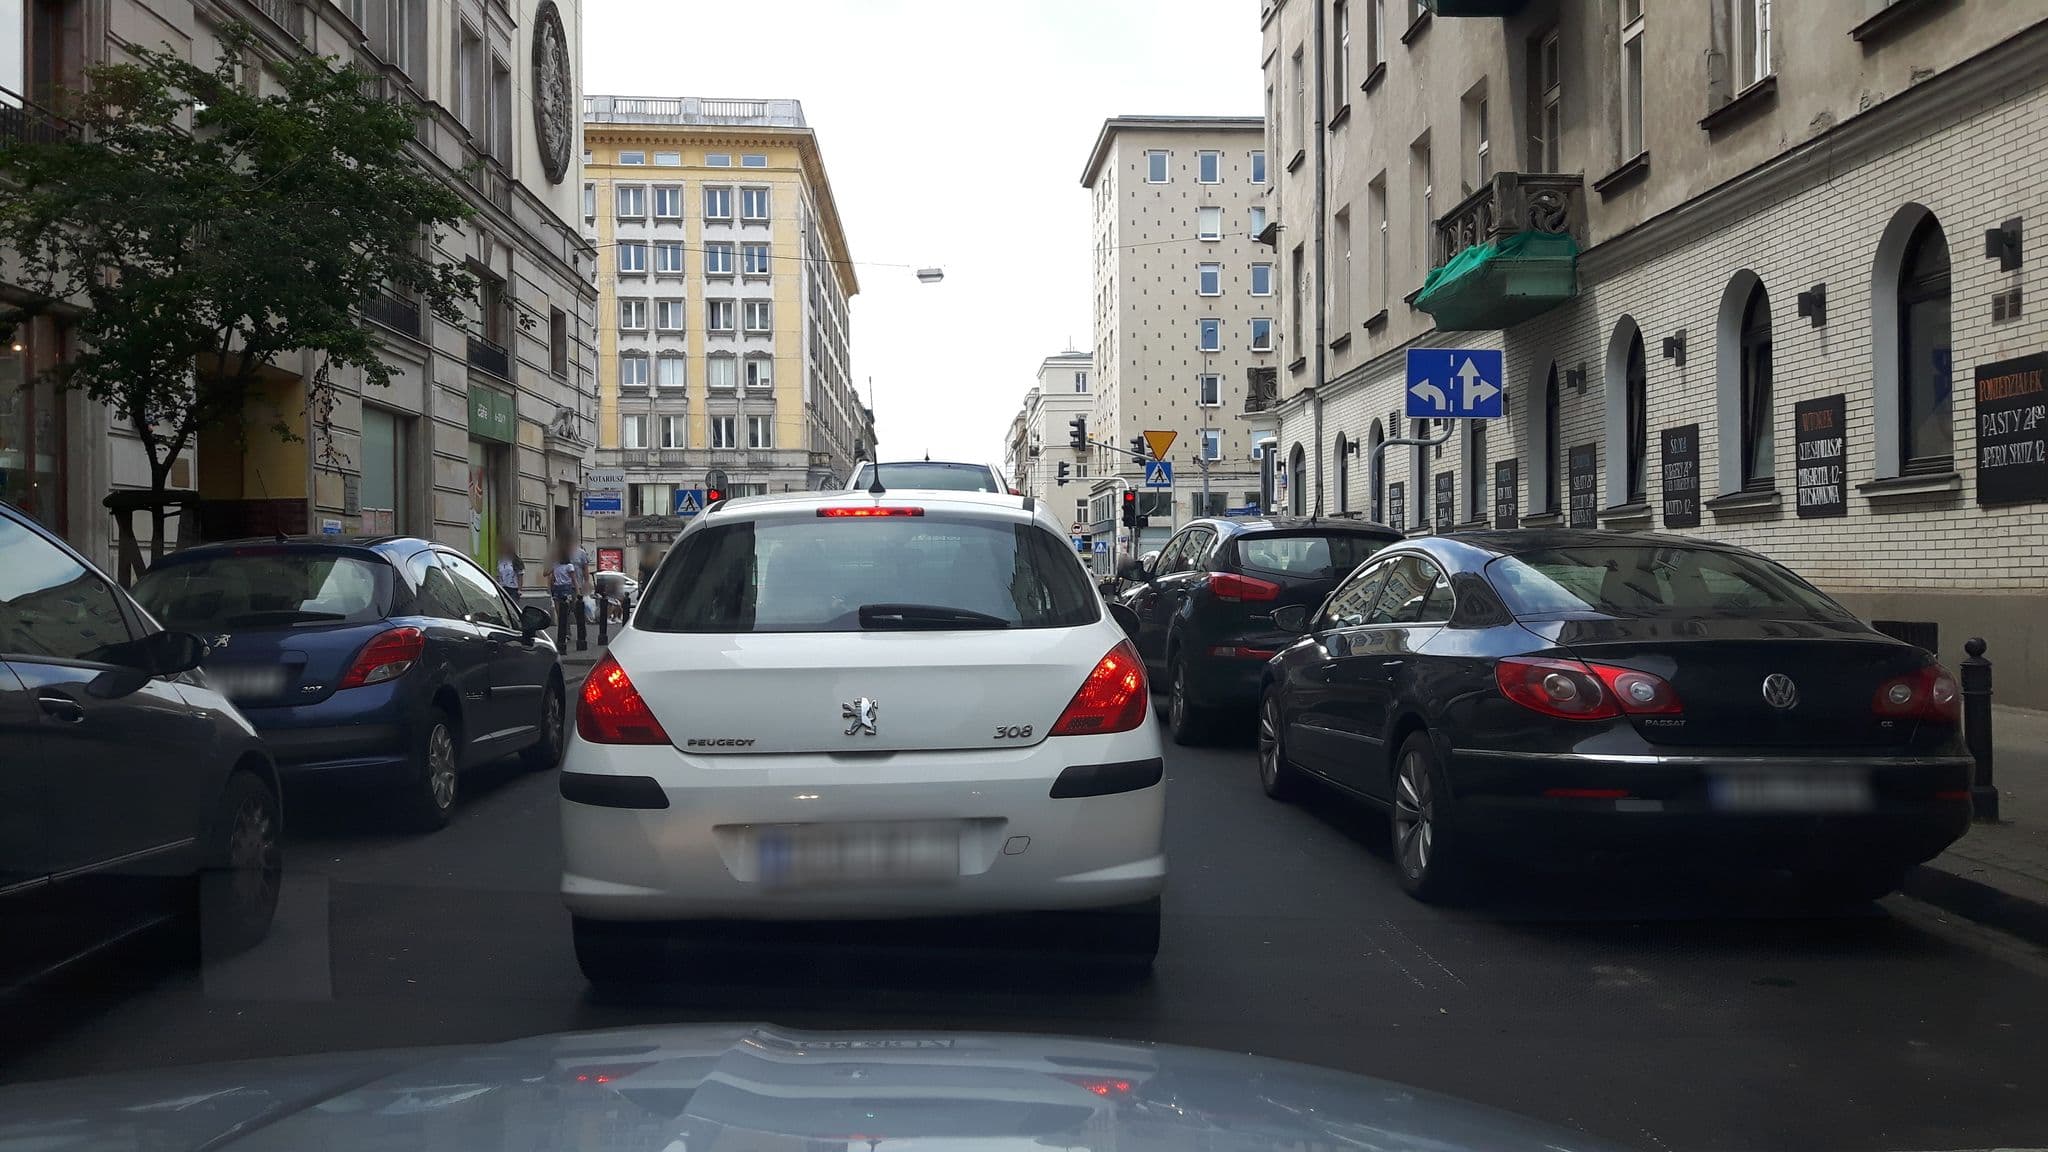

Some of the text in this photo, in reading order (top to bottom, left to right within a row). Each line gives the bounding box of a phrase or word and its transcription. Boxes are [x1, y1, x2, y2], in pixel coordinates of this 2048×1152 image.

[1982, 408, 2022, 437] PASTY
[2009, 441, 2033, 465] SPRITZ
[589, 475, 624, 483] NOTARIUSZ
[1645, 719, 1687, 727] PASSAT
[993, 725, 1034, 739] 308
[687, 738, 755, 748] PEUGEOT
